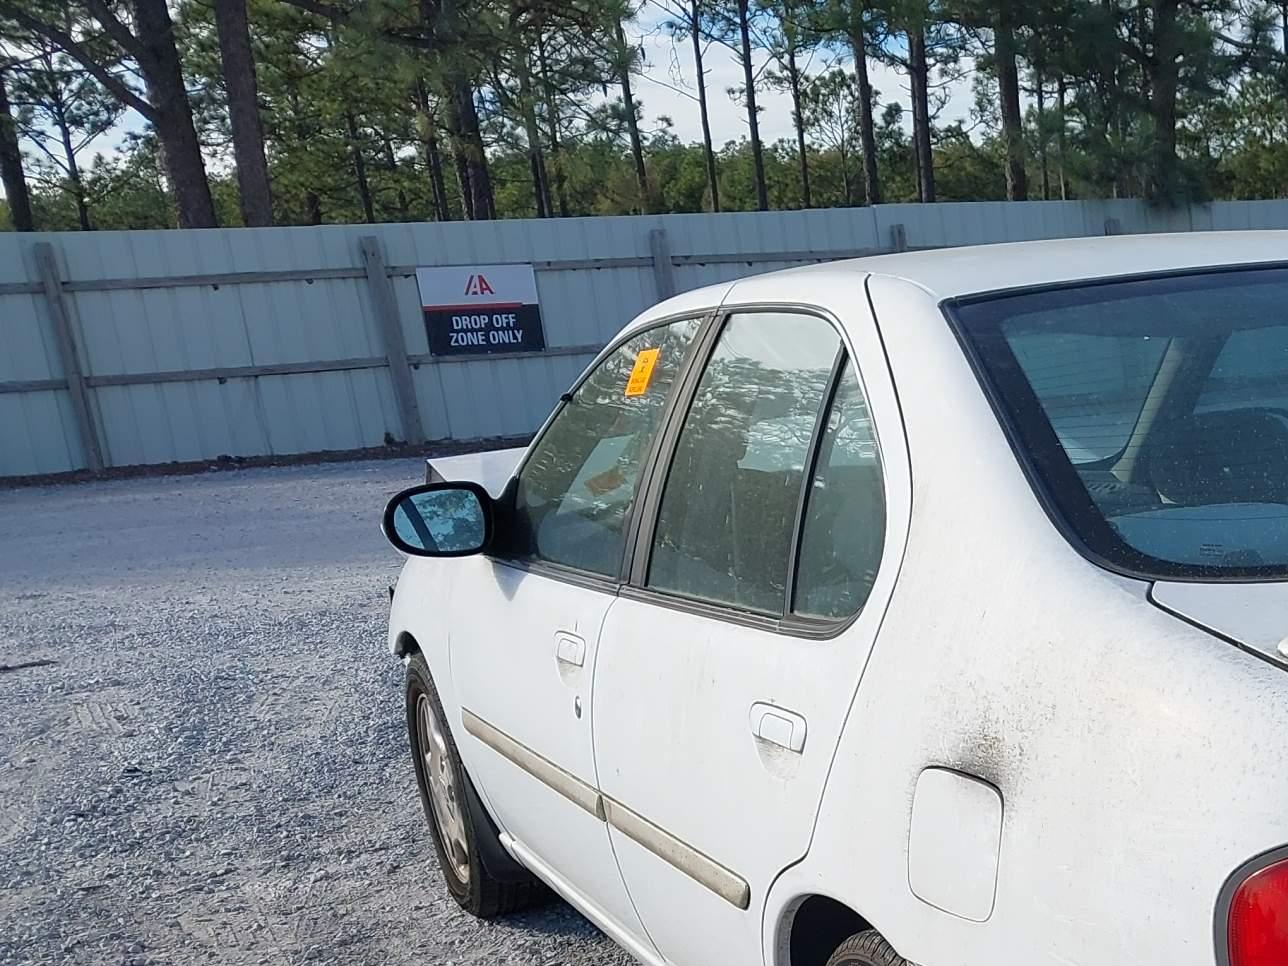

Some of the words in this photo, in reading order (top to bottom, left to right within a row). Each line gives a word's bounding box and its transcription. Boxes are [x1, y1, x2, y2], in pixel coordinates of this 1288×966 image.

[451, 315, 489, 330] DROP
[492, 313, 516, 328] OFF
[449, 331, 487, 346] ZONE
[489, 329, 523, 344] ONLY
